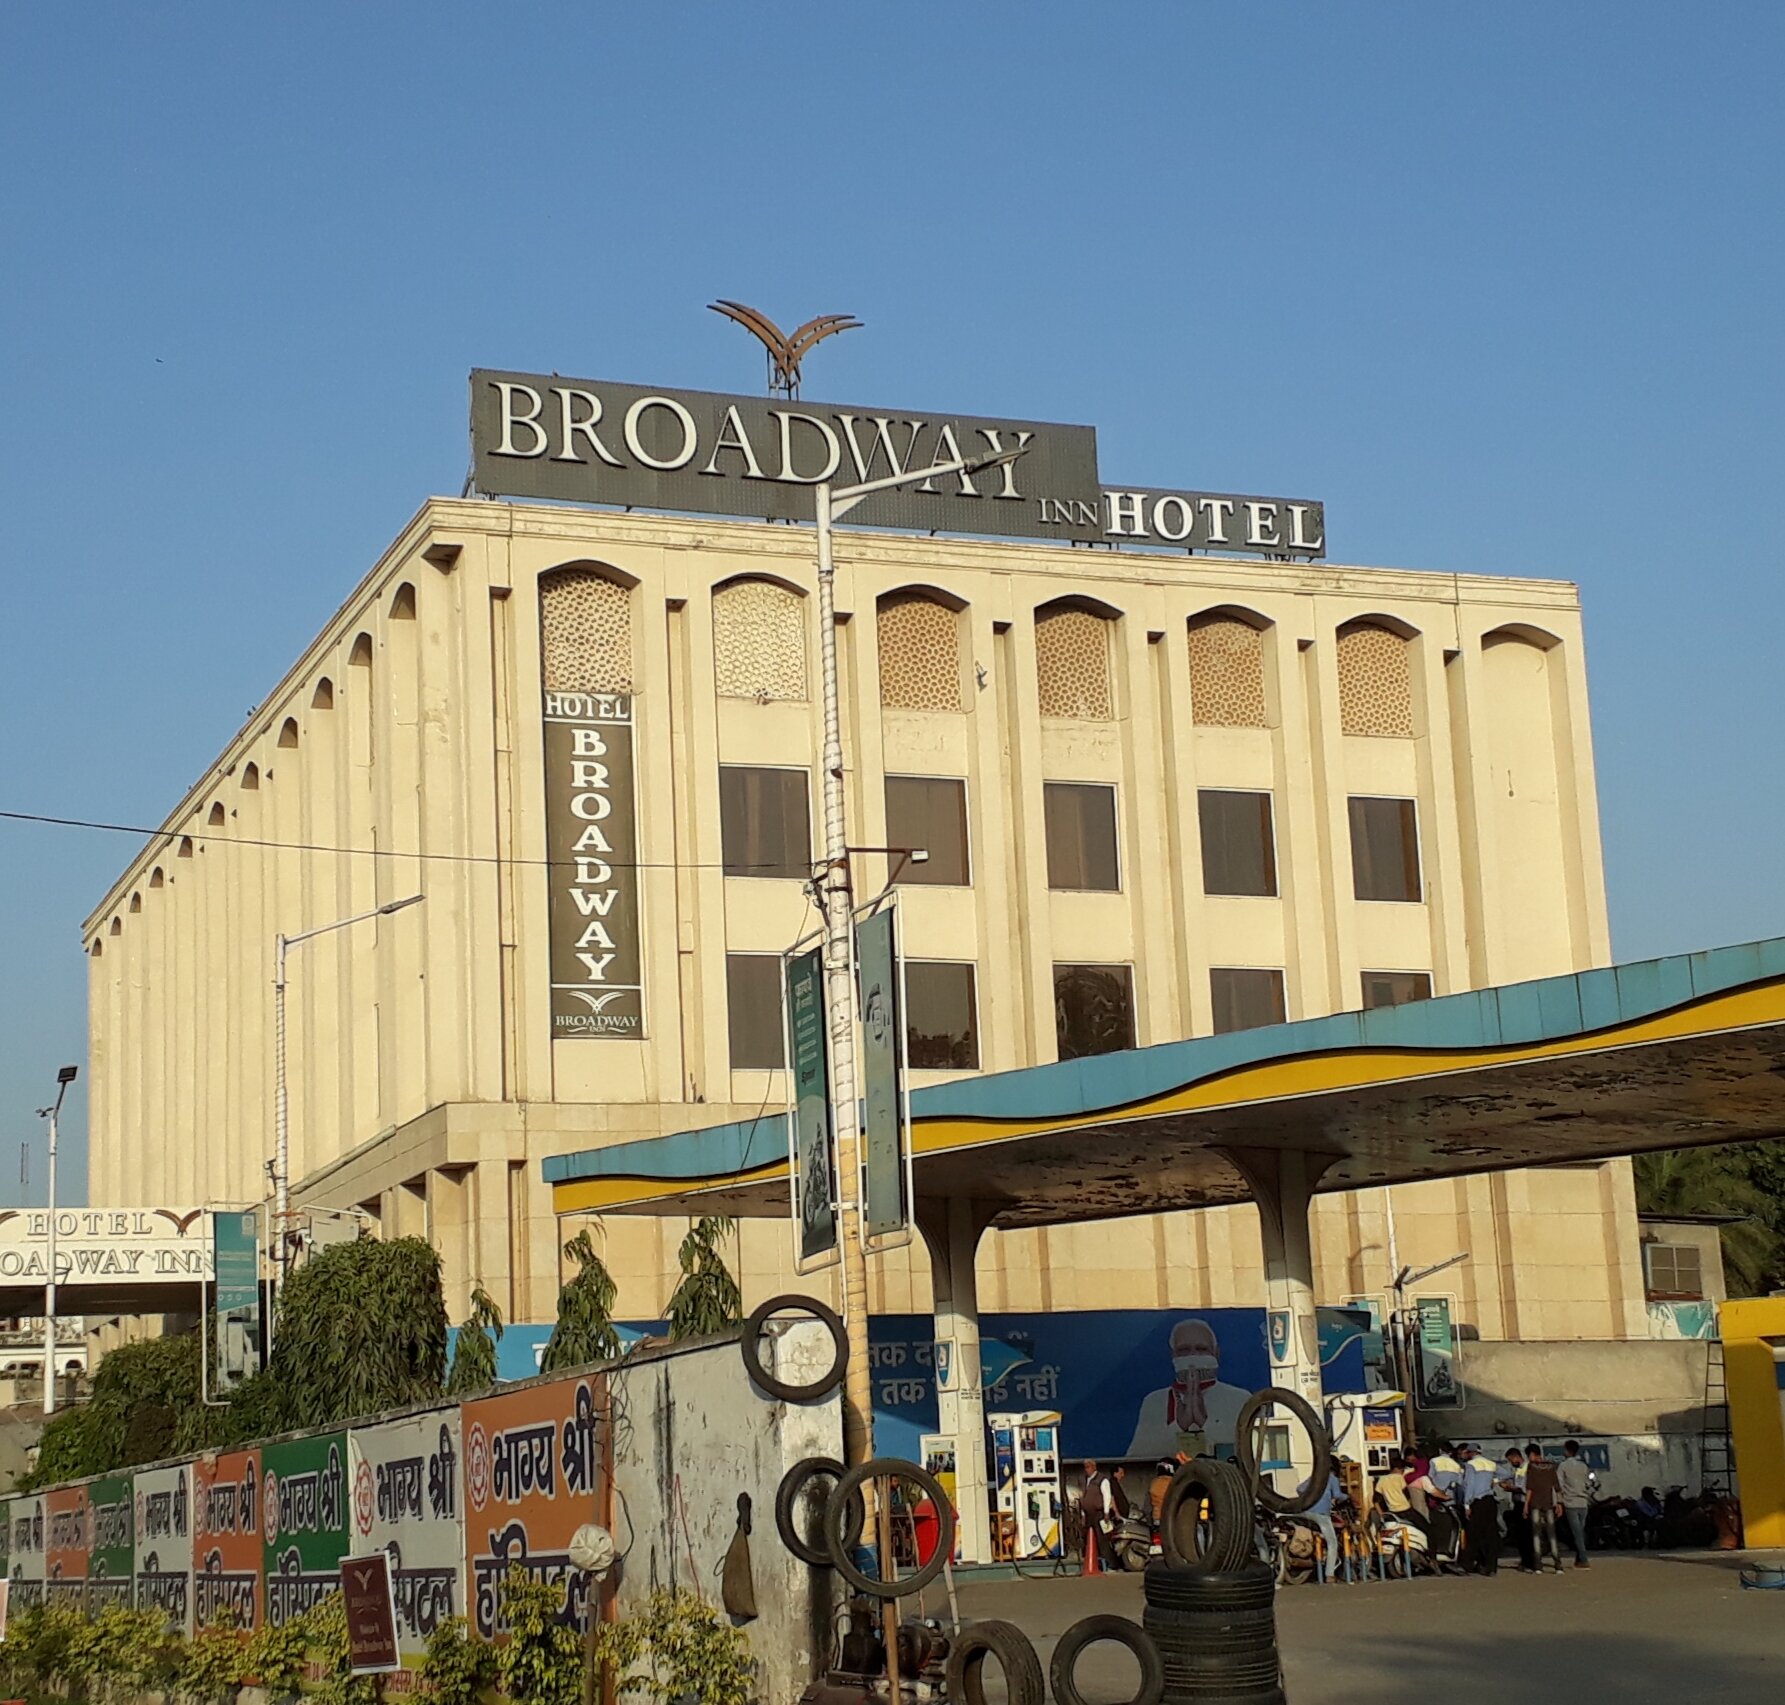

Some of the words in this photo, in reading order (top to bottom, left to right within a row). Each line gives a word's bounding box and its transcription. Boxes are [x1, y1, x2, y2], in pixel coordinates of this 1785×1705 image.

[488, 377, 1036, 501] BROADWAY
[1036, 498, 1099, 528] INN
[1103, 490, 1324, 551] HOTEL
[545, 694, 630, 719] HOTEL
[568, 728, 619, 982] BROADWAY
[555, 1014, 639, 1028] BROADWAY
[27, 1211, 153, 1237] HOTEL
[155, 1249, 214, 1274] INN
[879, 1378, 927, 1406] तक
[1013, 1365, 1061, 1401] नहीं
